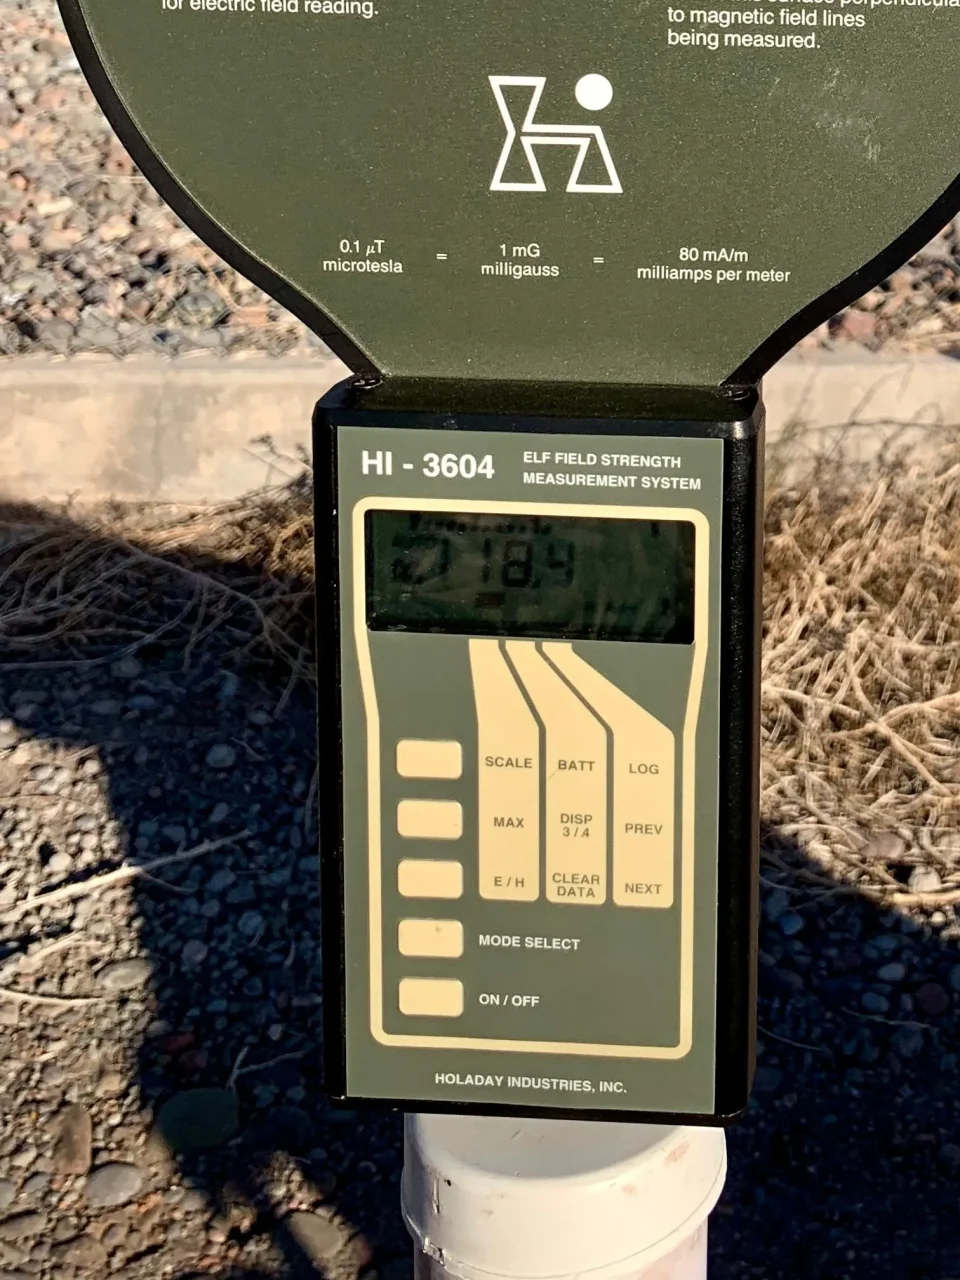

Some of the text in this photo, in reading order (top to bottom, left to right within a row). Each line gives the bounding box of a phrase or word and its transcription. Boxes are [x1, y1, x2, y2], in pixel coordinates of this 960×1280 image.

[667, 6, 866, 28] to magnetic field lines
[667, 28, 821, 51] being measured.
[339, 239, 360, 254] 0.1
[512, 242, 541, 258] mG
[679, 247, 749, 263] 80 mA/m
[322, 258, 404, 274] microtesla
[481, 261, 560, 280] milligauss
[637, 265, 791, 284] milliamps per meter
[362, 450, 393, 476] HI
[422, 452, 495, 479] 3604
[523, 451, 681, 469] ELF FIELD STRENGTH
[523, 471, 701, 490] MEASUREMENT SYSTEM
[484, 755, 533, 769] SCALE
[557, 759, 596, 772] BATT
[629, 763, 660, 775] LOG
[493, 816, 525, 828] MAX
[560, 813, 593, 825] DISP
[624, 822, 663, 835] PREV
[552, 872, 600, 885] CLEAR
[556, 885, 596, 898] DATA
[624, 882, 662, 895] NEXT
[478, 934, 581, 951] MODE SELECT
[478, 993, 500, 1006] ON
[511, 995, 540, 1008] OFF
[435, 1072, 627, 1094] HOLADAY INDUSTRIES, INC.
